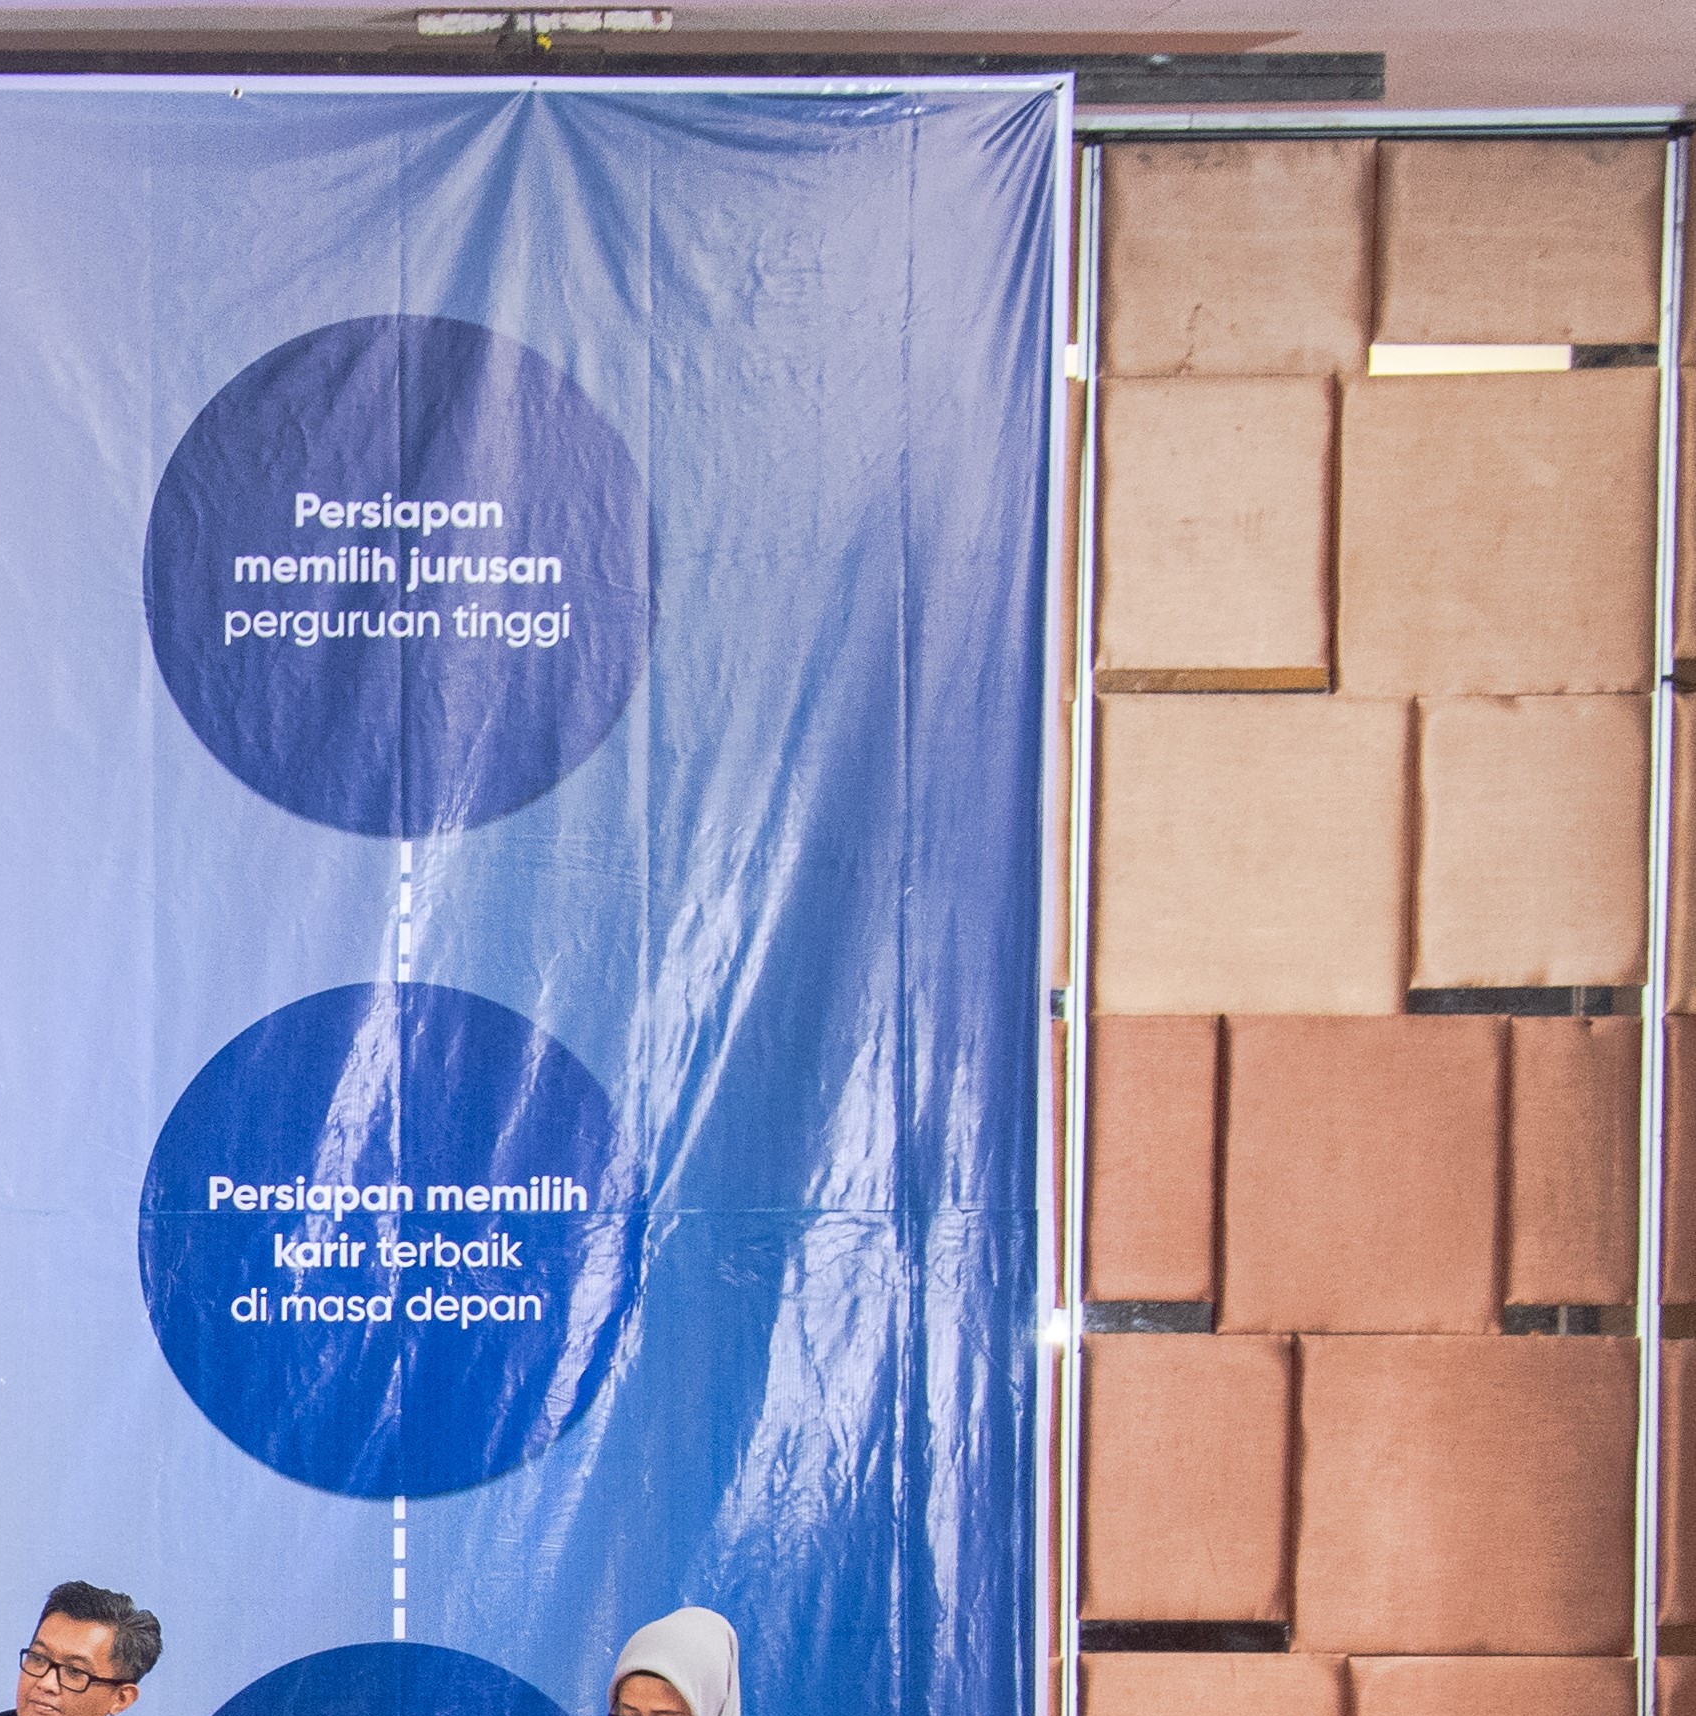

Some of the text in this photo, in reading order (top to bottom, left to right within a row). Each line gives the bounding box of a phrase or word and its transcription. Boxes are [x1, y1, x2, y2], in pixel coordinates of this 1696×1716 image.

[294, 492, 504, 537] Persiapan
[233, 546, 563, 592] memilih jurusan
[223, 602, 573, 648] perguruan tinggi
[208, 1175, 588, 1221] Persiapan memilih
[273, 1232, 523, 1269] karir terbaik
[230, 1287, 542, 1330] di masa depan
